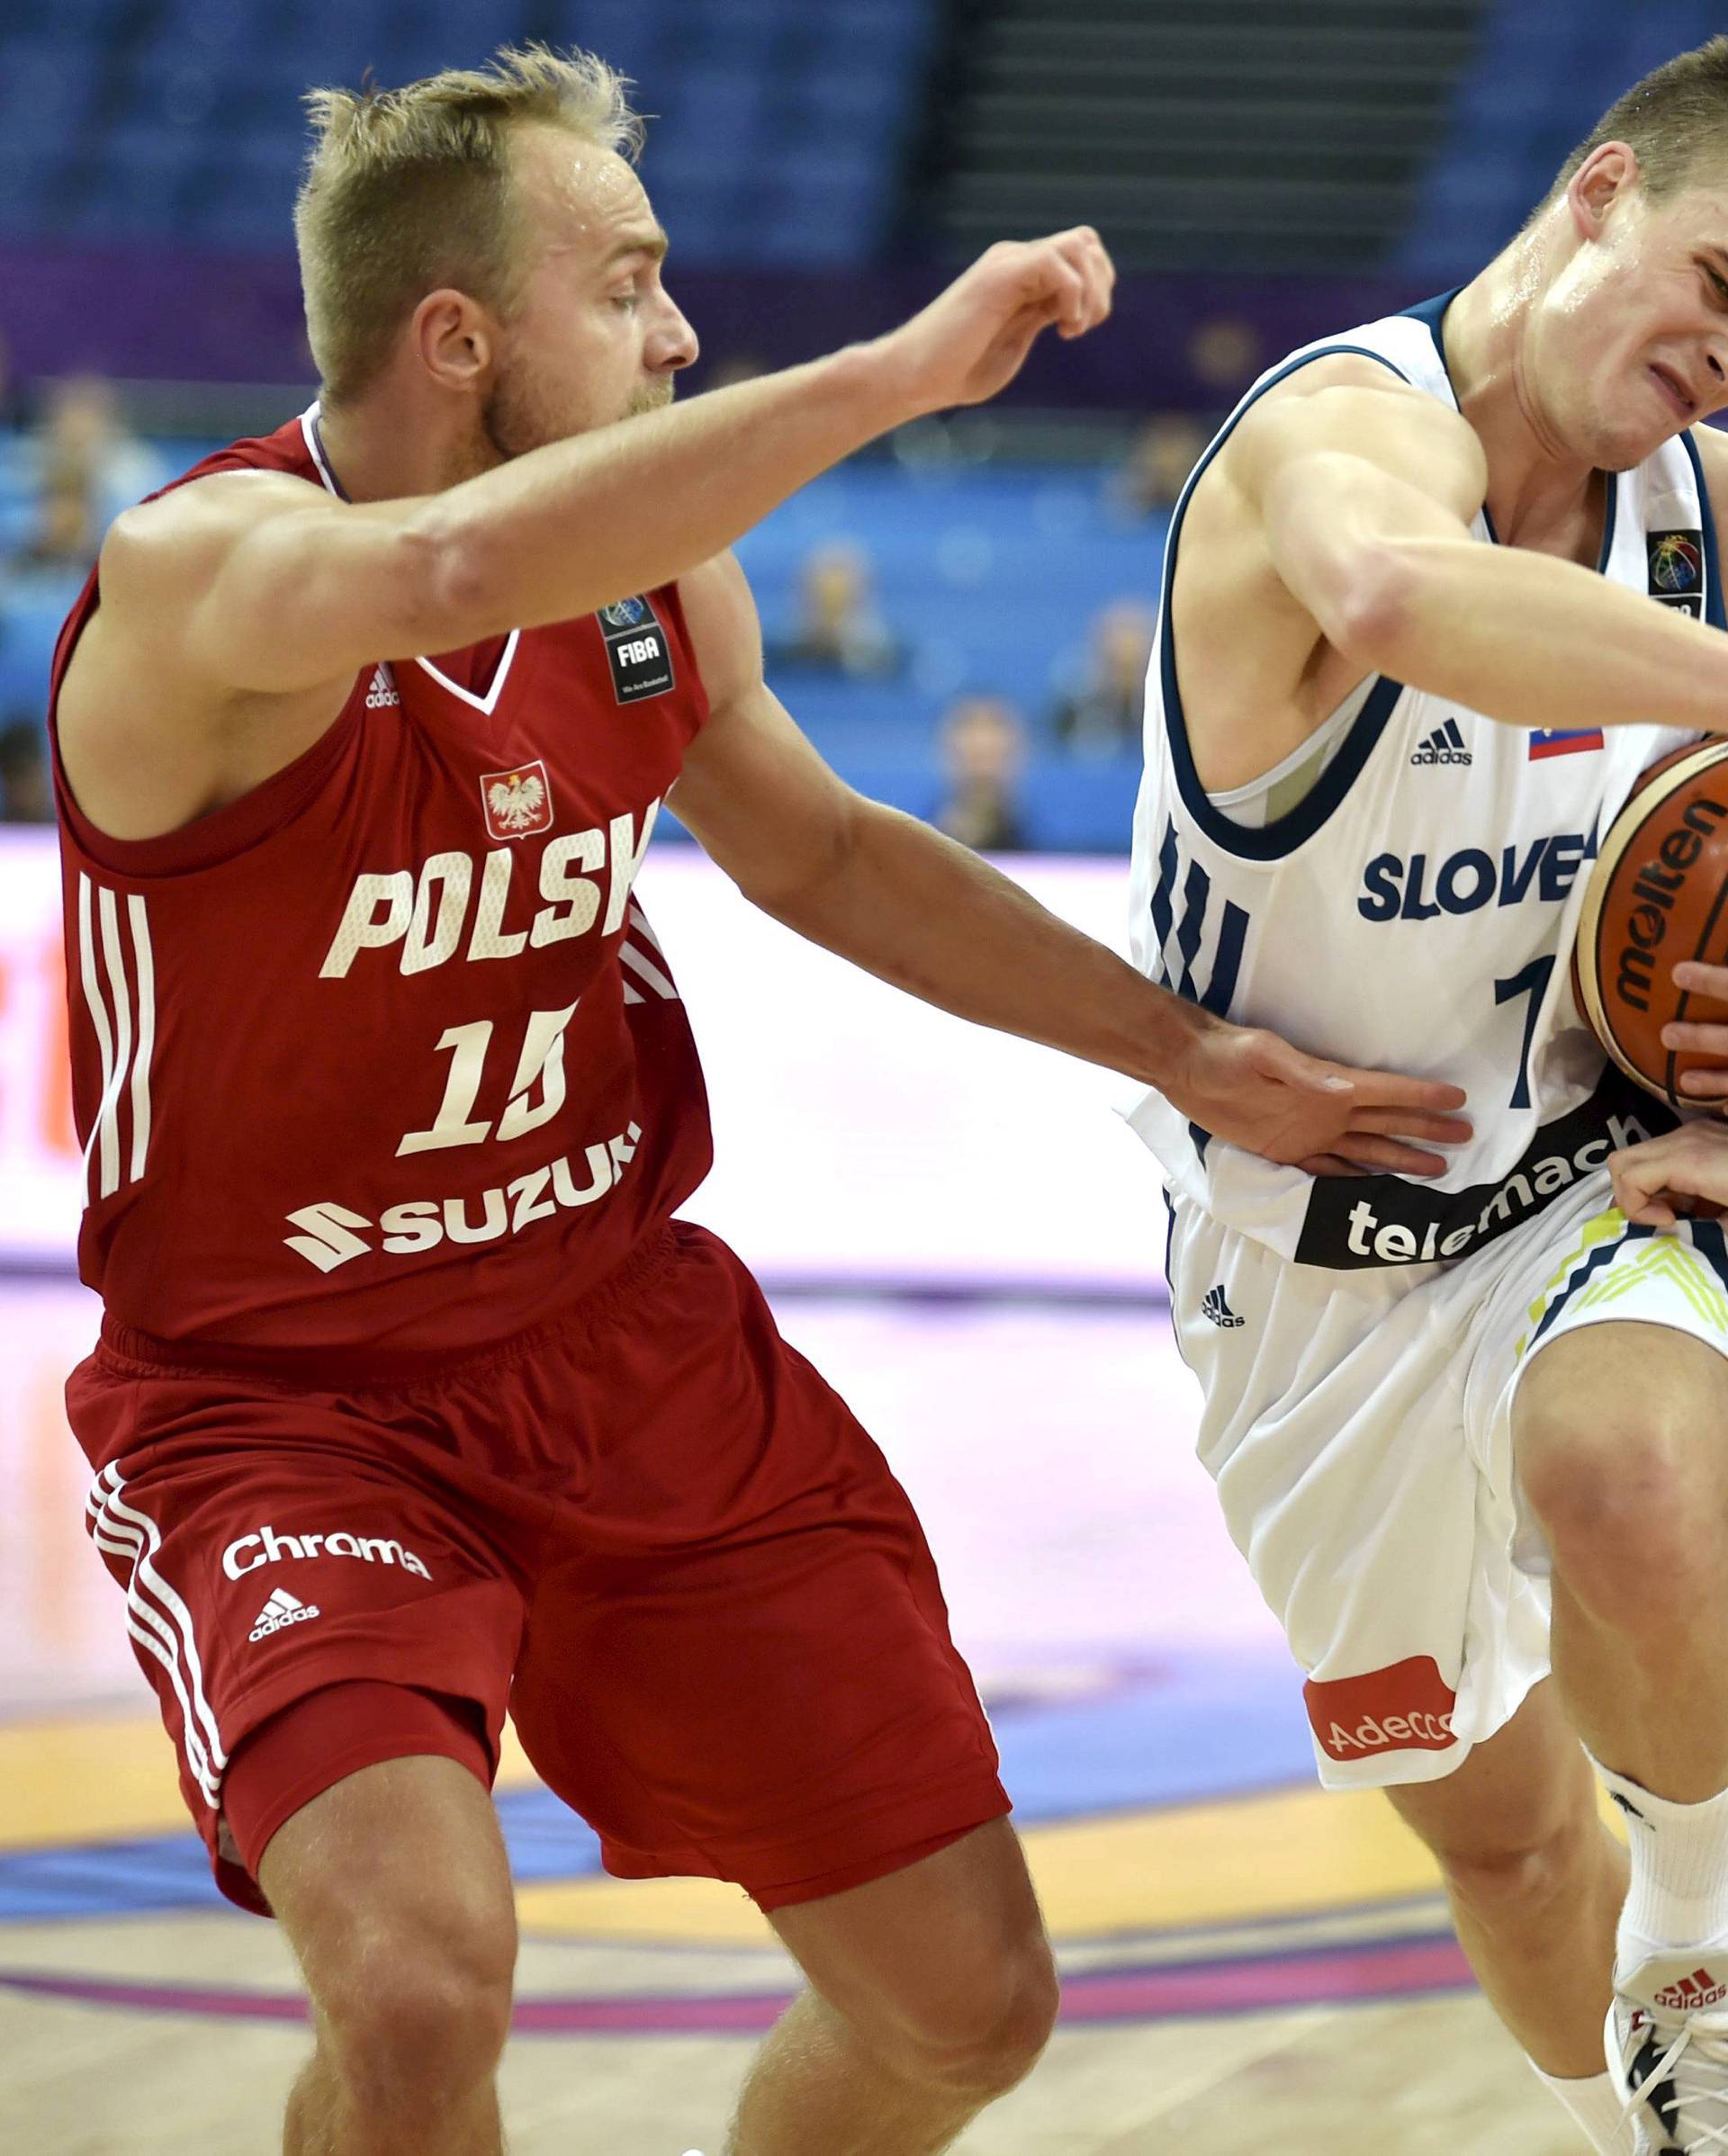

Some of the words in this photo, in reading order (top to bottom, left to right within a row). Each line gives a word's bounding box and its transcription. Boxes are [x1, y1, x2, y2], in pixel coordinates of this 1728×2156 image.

[616, 636, 660, 667] FIBA
[1410, 748, 1472, 766] adidas
[1617, 798, 1727, 1012] molten
[1348, 1114, 1652, 1262] telemach
[222, 1526, 433, 1581] Chroma
[248, 1604, 320, 1641] adidas
[1654, 1983, 1727, 2010] adidas
